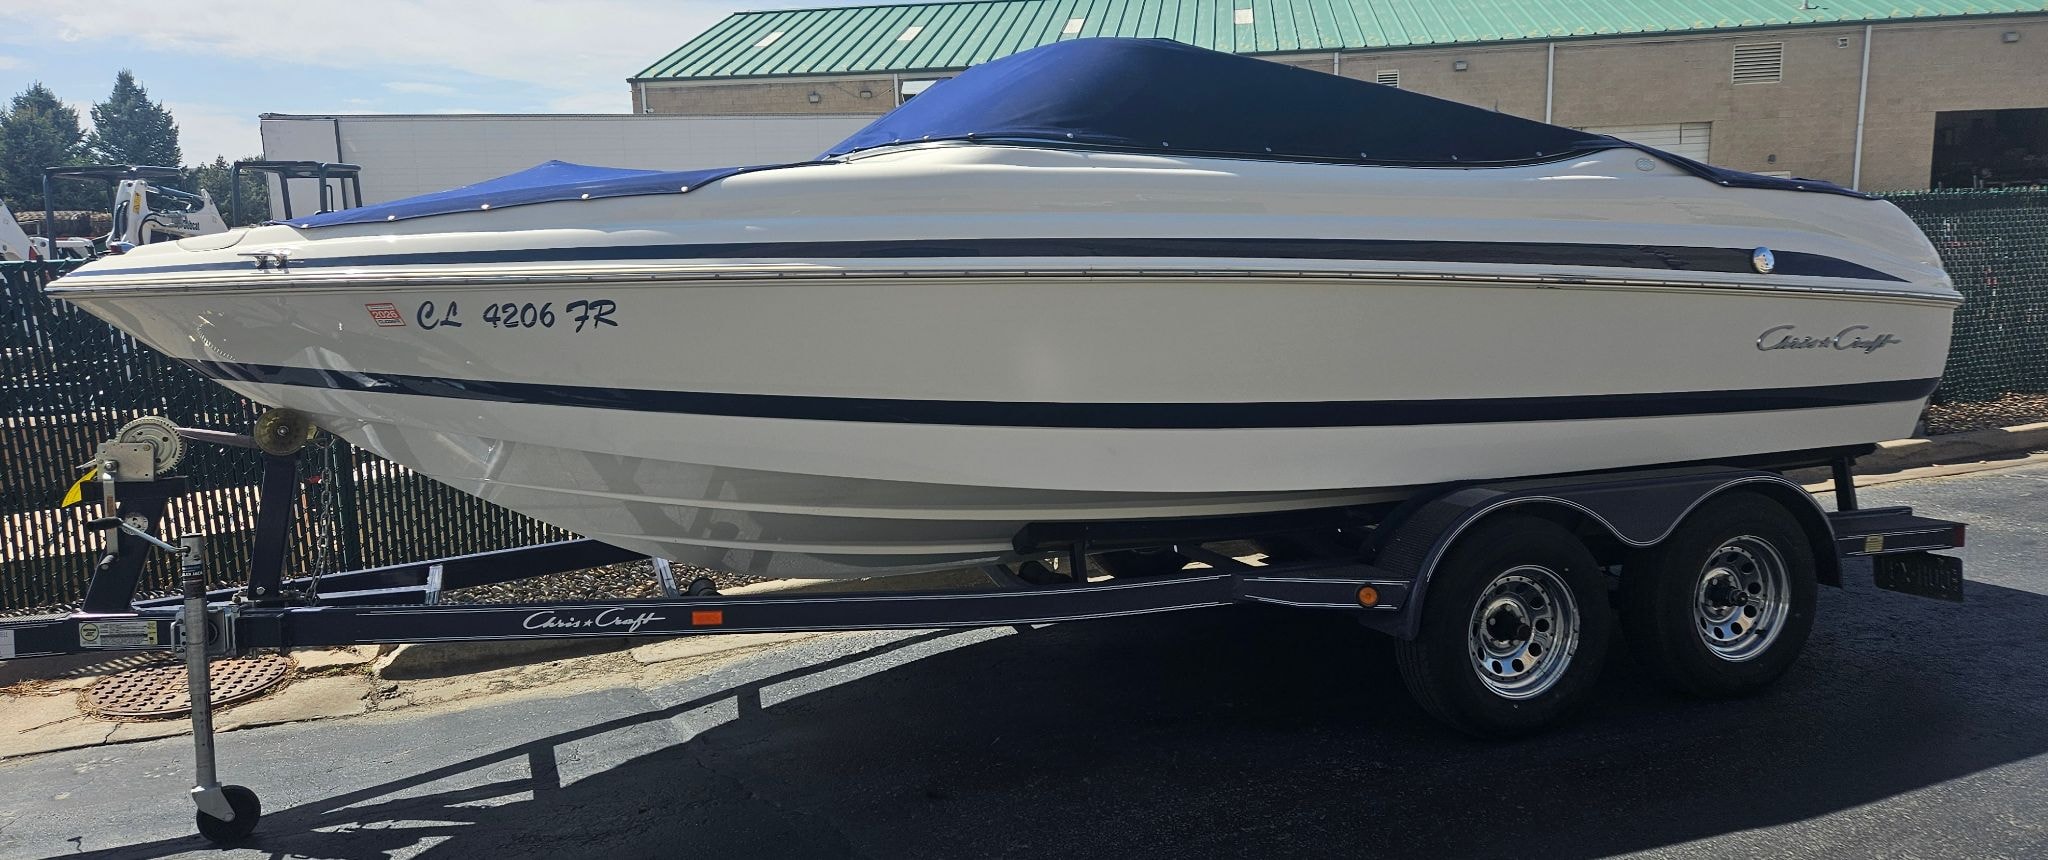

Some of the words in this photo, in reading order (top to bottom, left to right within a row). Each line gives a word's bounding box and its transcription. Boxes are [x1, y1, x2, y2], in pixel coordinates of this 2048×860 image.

[416, 300, 463, 330] CL
[482, 301, 556, 329] 4206
[565, 299, 619, 334] FR
[1756, 324, 1817, 351] Chris
[1832, 324, 1902, 355] Craft
[522, 610, 581, 630] Chris
[594, 607, 667, 633] Craft
